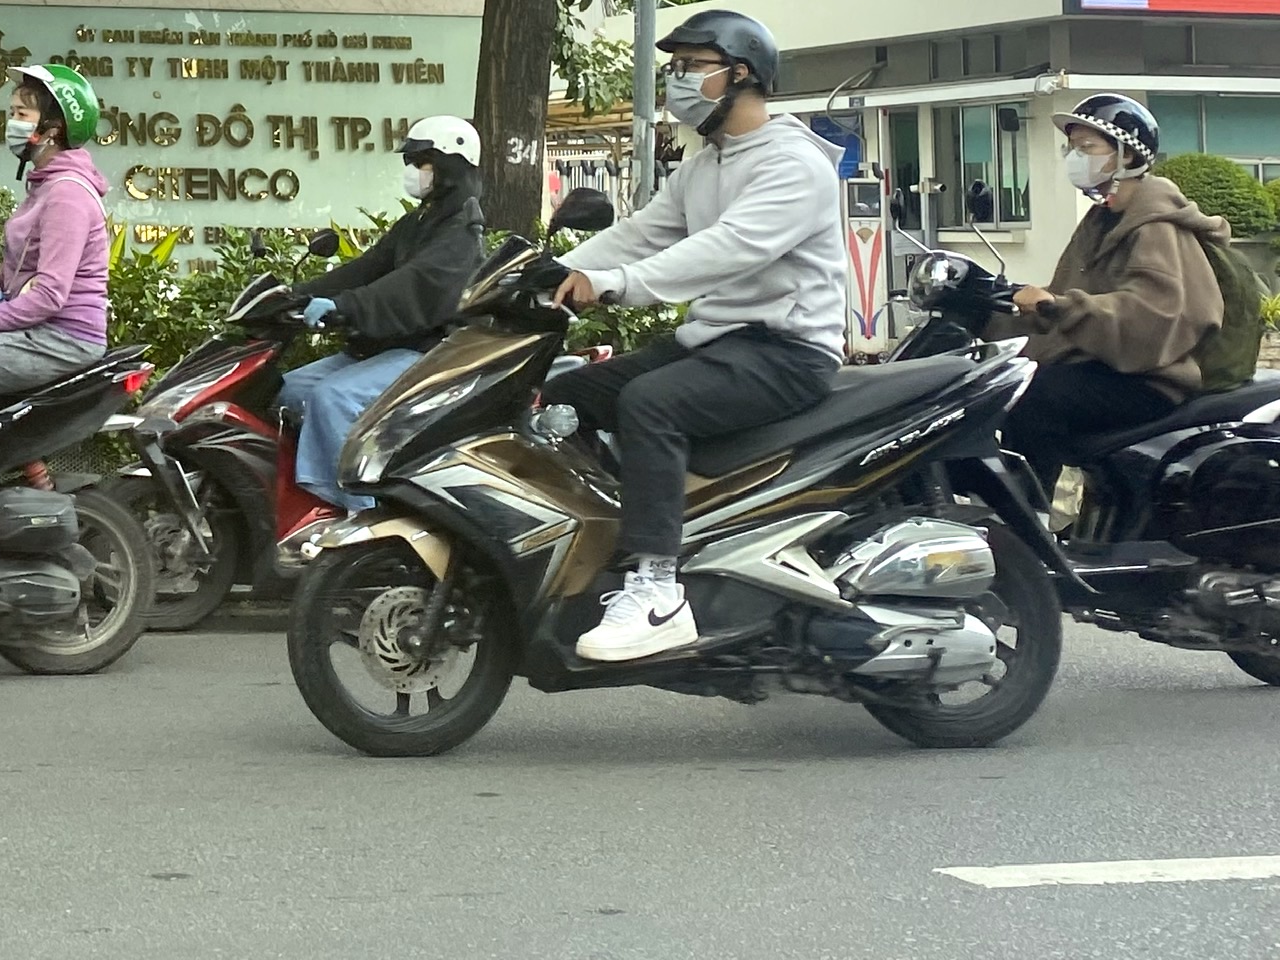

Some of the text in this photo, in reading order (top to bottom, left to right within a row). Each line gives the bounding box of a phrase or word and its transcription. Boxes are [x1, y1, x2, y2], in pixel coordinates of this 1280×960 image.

[126, 56, 154, 78] TY
[167, 57, 228, 79] TNHH
[240, 55, 289, 85] MỘT
[302, 56, 380, 83] THÀNH
[391, 58, 445, 84] VIÊN
[61, 85, 85, 122] Grab
[195, 103, 254, 147] ĐÔ
[266, 115, 319, 160] THỊ
[331, 116, 375, 152] TP.
[124, 164, 300, 202] CITENCO
